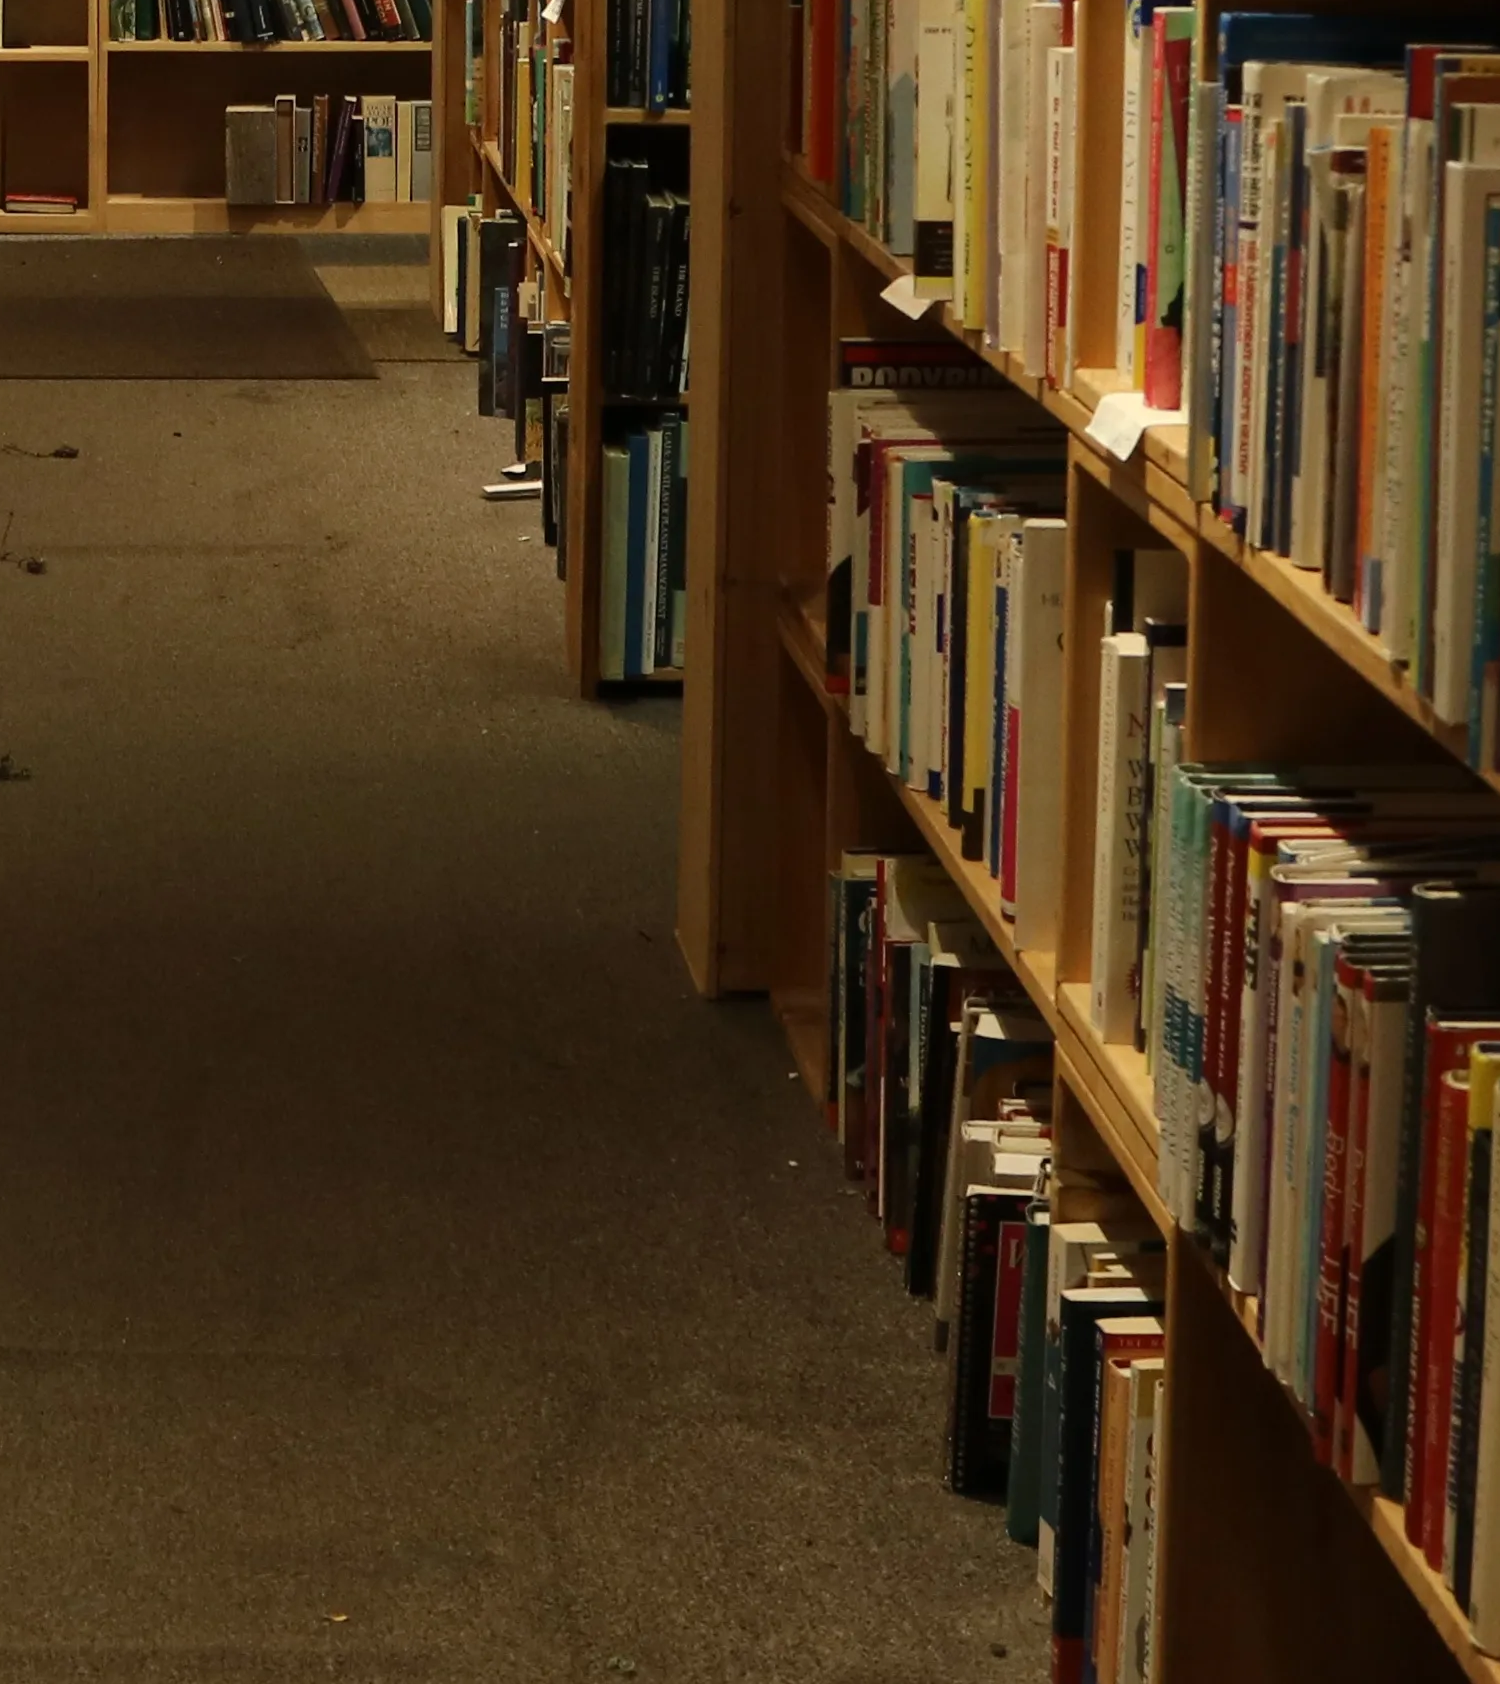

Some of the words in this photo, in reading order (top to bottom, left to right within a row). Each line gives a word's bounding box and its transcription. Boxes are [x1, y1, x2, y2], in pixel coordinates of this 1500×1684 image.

[383, 0, 392, 11] IN
[366, 117, 392, 127] POE
[1051, 121, 1061, 152] Phil
[1121, 90, 1137, 206] BREAST
[1050, 155, 1061, 221] McGraw
[649, 284, 660, 319] ISLAND
[651, 266, 661, 283] THE
[675, 283, 686, 317] ISLAND
[676, 265, 686, 282] THE
[1121, 225, 1136, 320] BOOK
[1483, 246, 1500, 317] Back
[1242, 265, 1258, 363] CARBOHYDRATE
[1475, 326, 1500, 456] Together
[660, 473, 671, 503] ATLAS
[661, 459, 672, 471] AN
[659, 516, 671, 550] PLANET
[657, 552, 670, 619] MANAGEMENT
[1206, 835, 1219, 910] Perfect
[1221, 849, 1236, 924] Perfect
[1203, 916, 1217, 986] Weight
[1218, 931, 1235, 1001] Weight
[1201, 994, 1211, 1063] AMERICA
[1217, 1008, 1227, 1080] AMERICA
[1287, 1005, 1301, 1092] Suzanne
[1196, 1150, 1206, 1202] JORDAN
[1284, 1102, 1300, 1192] Somers'
[1323, 1127, 1345, 1204] Body
[1213, 1164, 1222, 1220] JORDAN
[1317, 1252, 1341, 1334] LIFE
